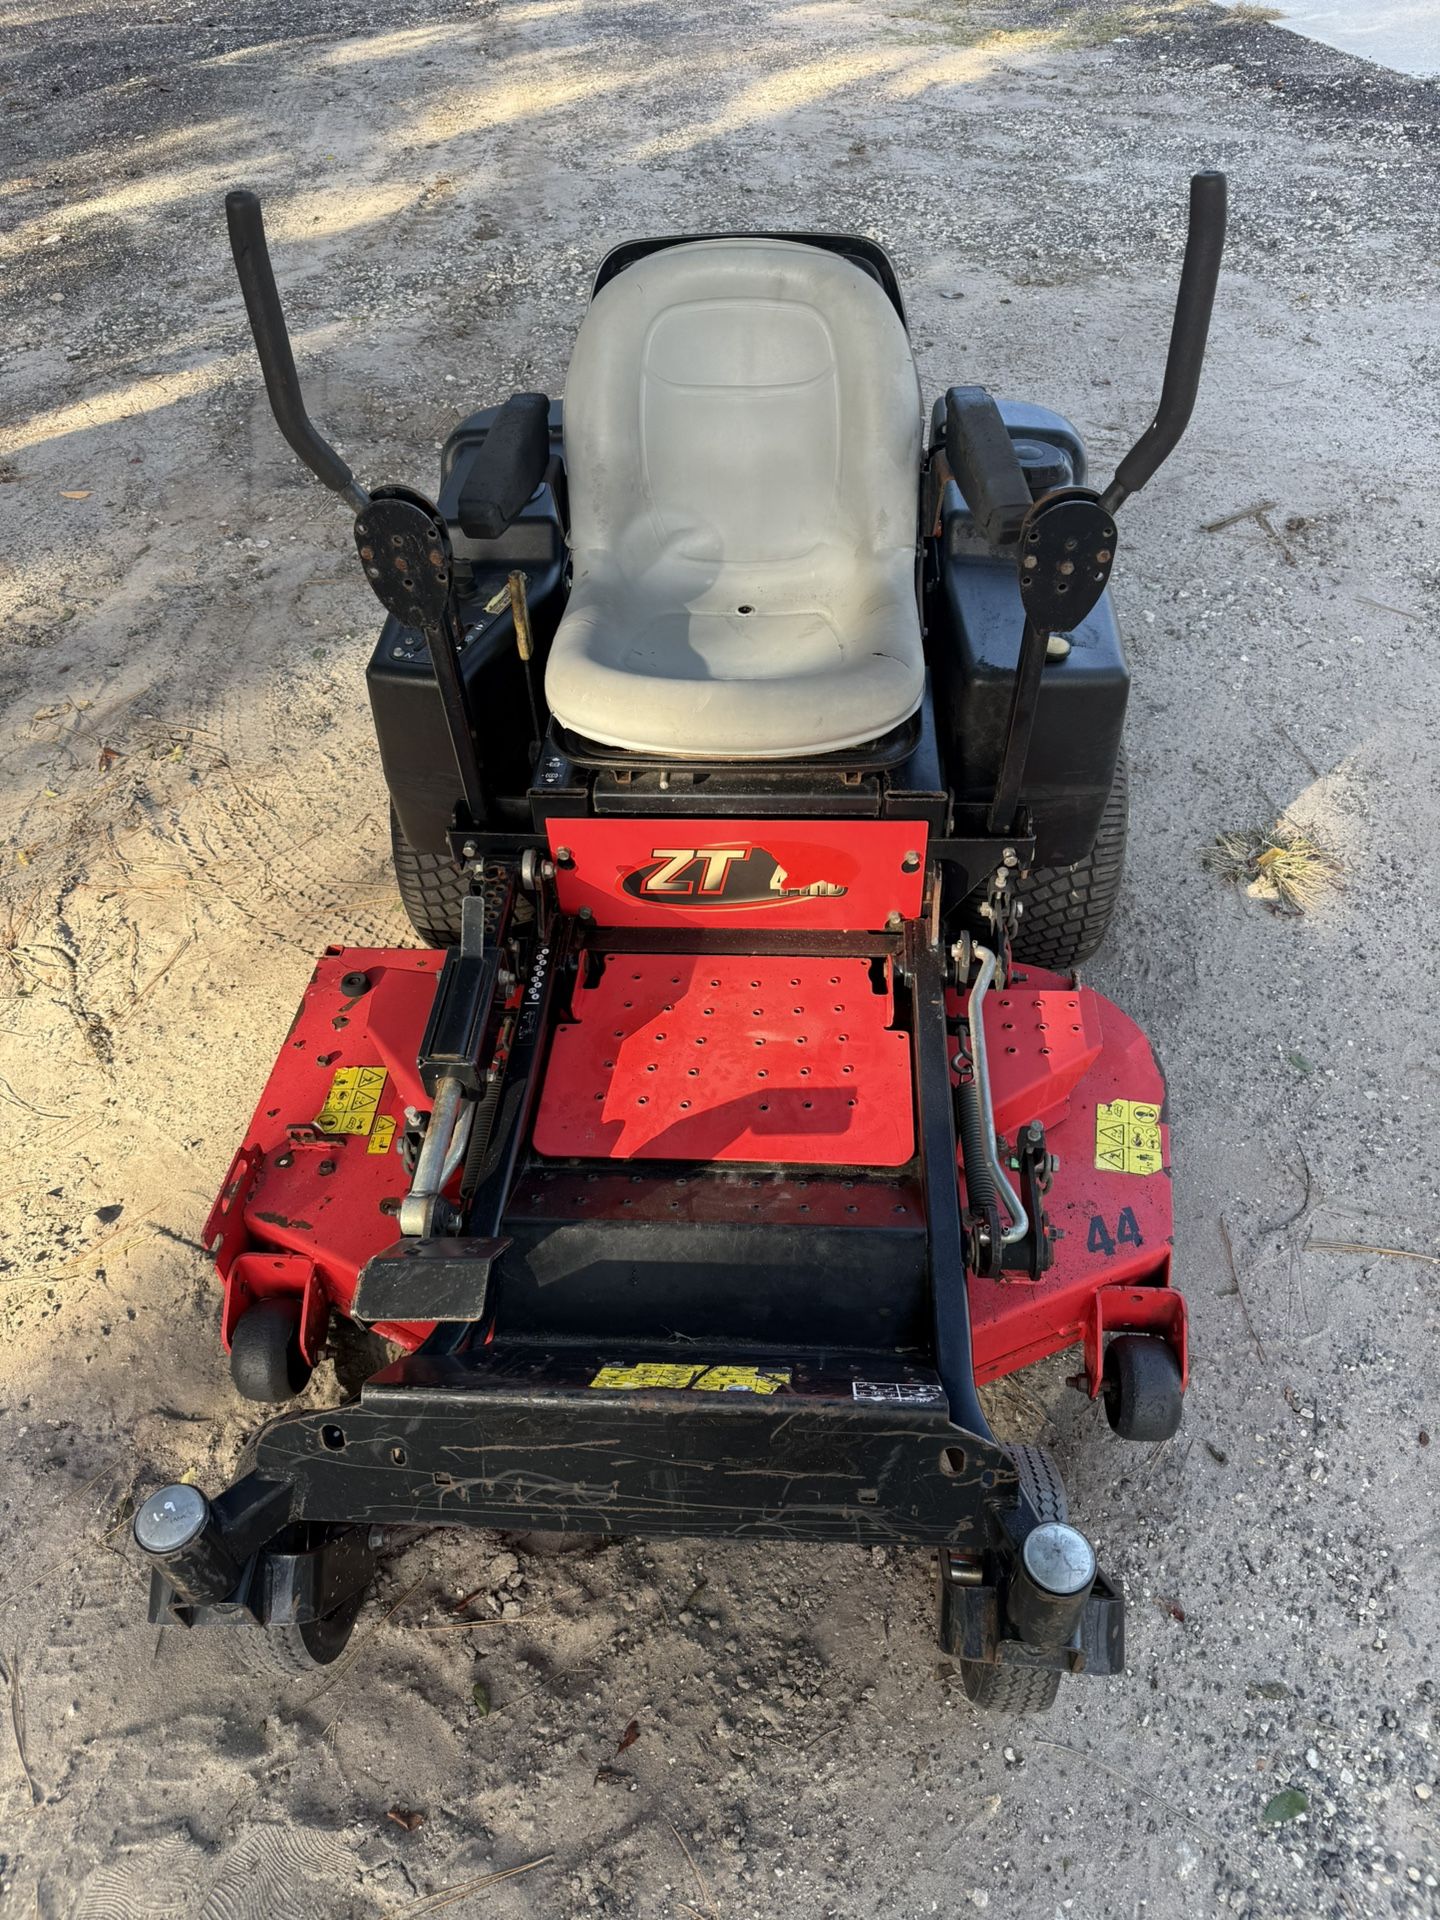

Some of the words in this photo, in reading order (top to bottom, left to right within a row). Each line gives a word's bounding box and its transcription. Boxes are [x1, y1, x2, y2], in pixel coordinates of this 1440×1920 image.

[640, 848, 750, 895] ZT
[770, 864, 848, 896] 4H
[1087, 1206, 1144, 1256] 44
